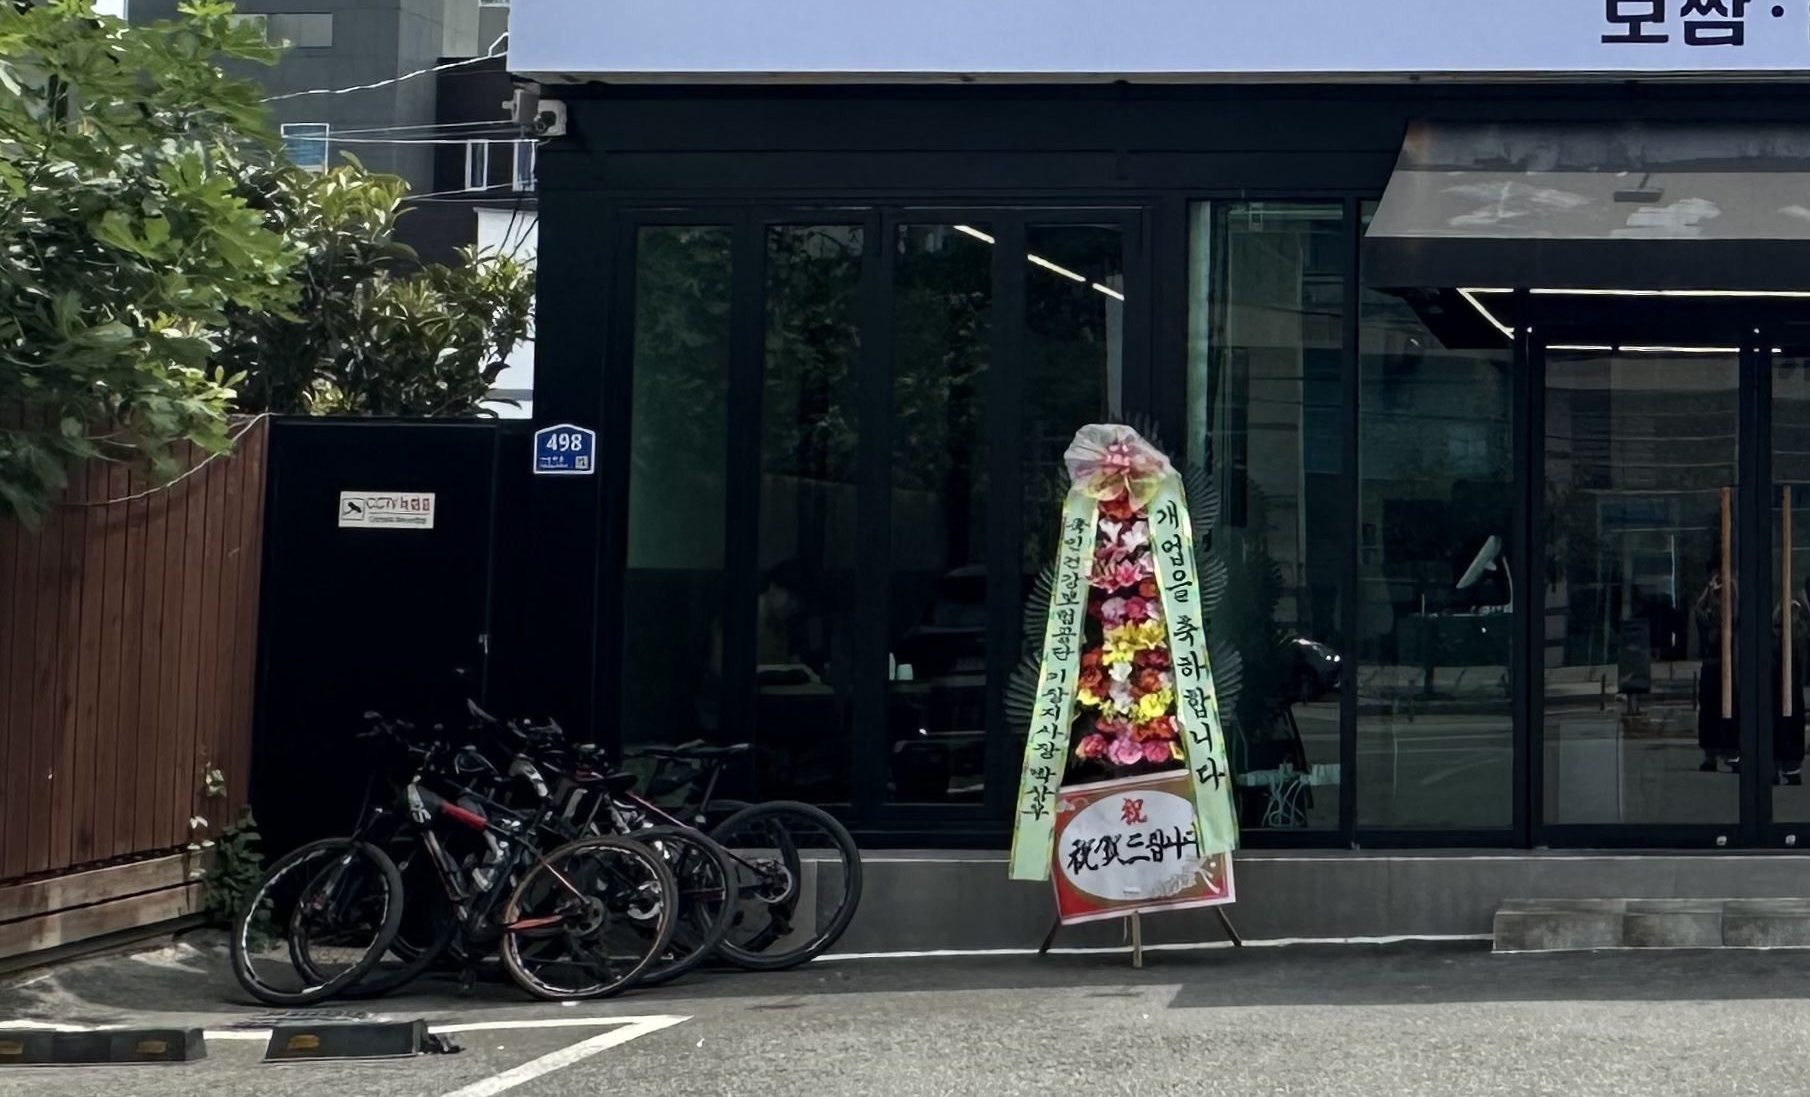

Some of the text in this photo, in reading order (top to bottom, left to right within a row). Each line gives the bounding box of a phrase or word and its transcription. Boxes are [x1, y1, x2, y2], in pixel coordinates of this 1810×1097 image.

[546, 433, 583, 452] 498
[1156, 500, 1226, 792] 개업을 축하합니다
[1120, 797, 1148, 826] 祝
